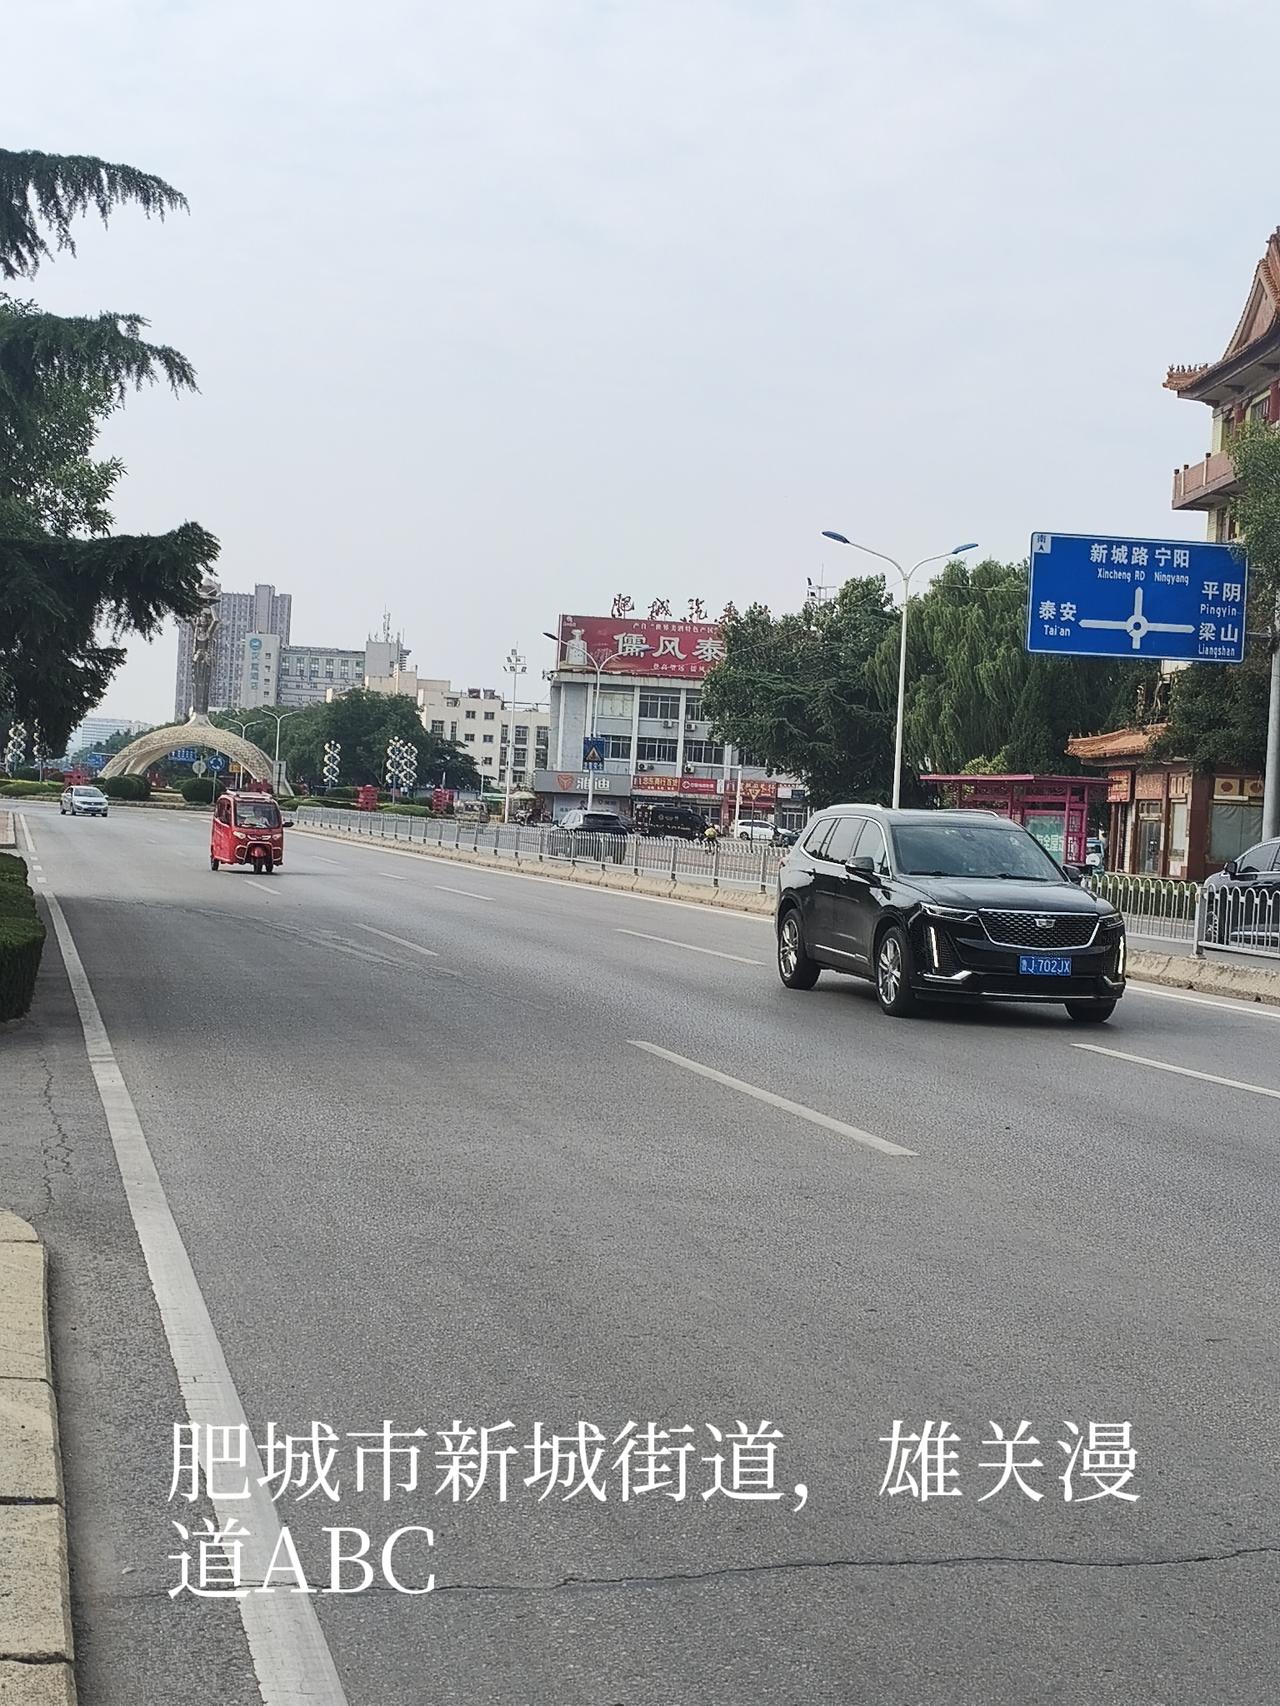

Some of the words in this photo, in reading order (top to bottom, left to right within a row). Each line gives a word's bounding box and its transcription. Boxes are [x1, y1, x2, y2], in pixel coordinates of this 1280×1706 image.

[1090, 543, 1149, 567] 新城路
[1154, 548, 1190, 568] 宁阳
[1097, 567, 1132, 583] Xincheng
[1134, 570, 1146, 581] RD
[1154, 572, 1189, 586] Ningyang
[1201, 581, 1242, 602] 平阴
[1038, 600, 1077, 622] 泰安
[1200, 603, 1238, 618] Pingyin
[1198, 622, 1239, 643] 梁山
[613, 631, 727, 662] 儒风泰
[1198, 644, 1236, 658] Liangshan
